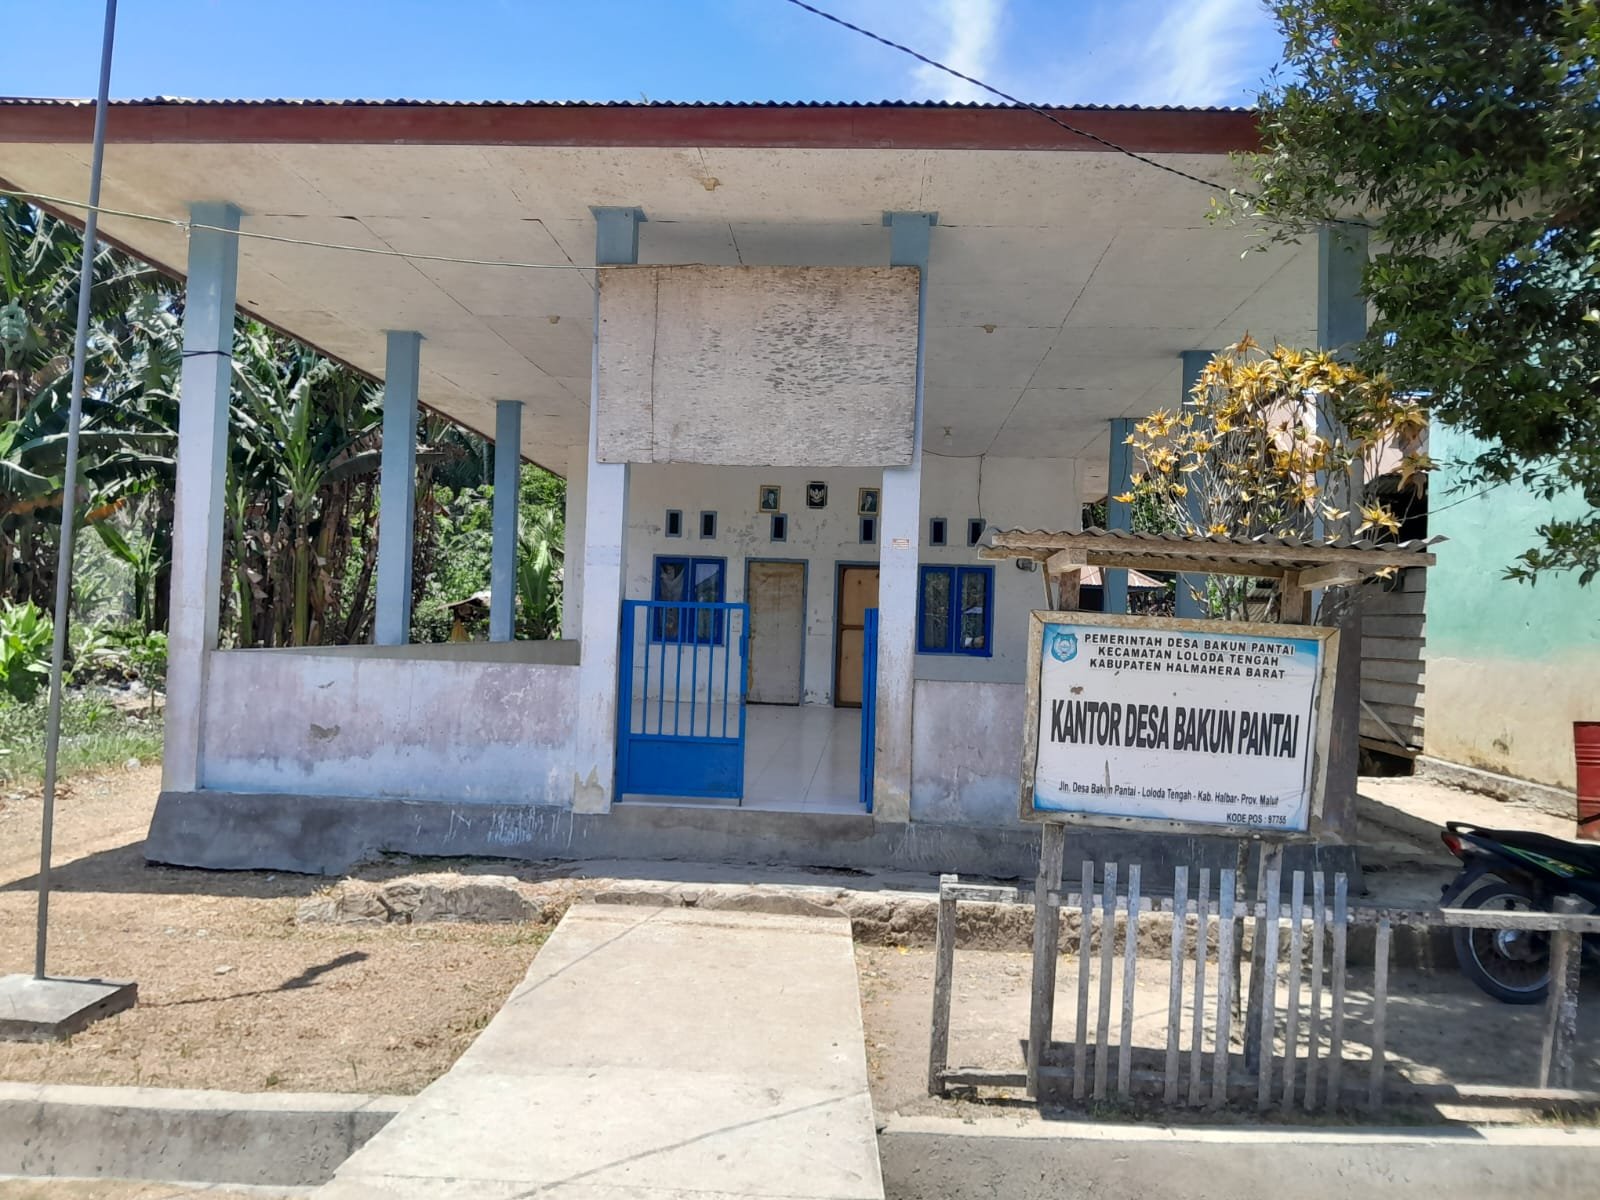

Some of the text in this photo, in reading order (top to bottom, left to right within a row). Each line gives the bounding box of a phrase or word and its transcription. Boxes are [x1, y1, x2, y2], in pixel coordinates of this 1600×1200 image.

[1084, 634, 1294, 655] PEMERINTAH DESA BAKUN PANTAI
[1098, 646, 1279, 666] KECAMATAN LOLODA TENGAH
[1090, 658, 1286, 679] KABUPATEN HALMAHERA BARAT
[1051, 700, 1300, 758] KANTOR DESA BAKUN PANTAI
[1058, 780, 1070, 792] Jln.
[1072, 782, 1090, 793] Desa
[1114, 784, 1136, 796] Pantai
[1142, 787, 1166, 798] Loloda
[1168, 788, 1192, 802] Tengah
[1198, 790, 1212, 802] Kab.
[1241, 794, 1258, 805] Prov.
[1226, 812, 1246, 823] KODE
[1248, 814, 1262, 824] POS
[1268, 815, 1287, 824] 97755
